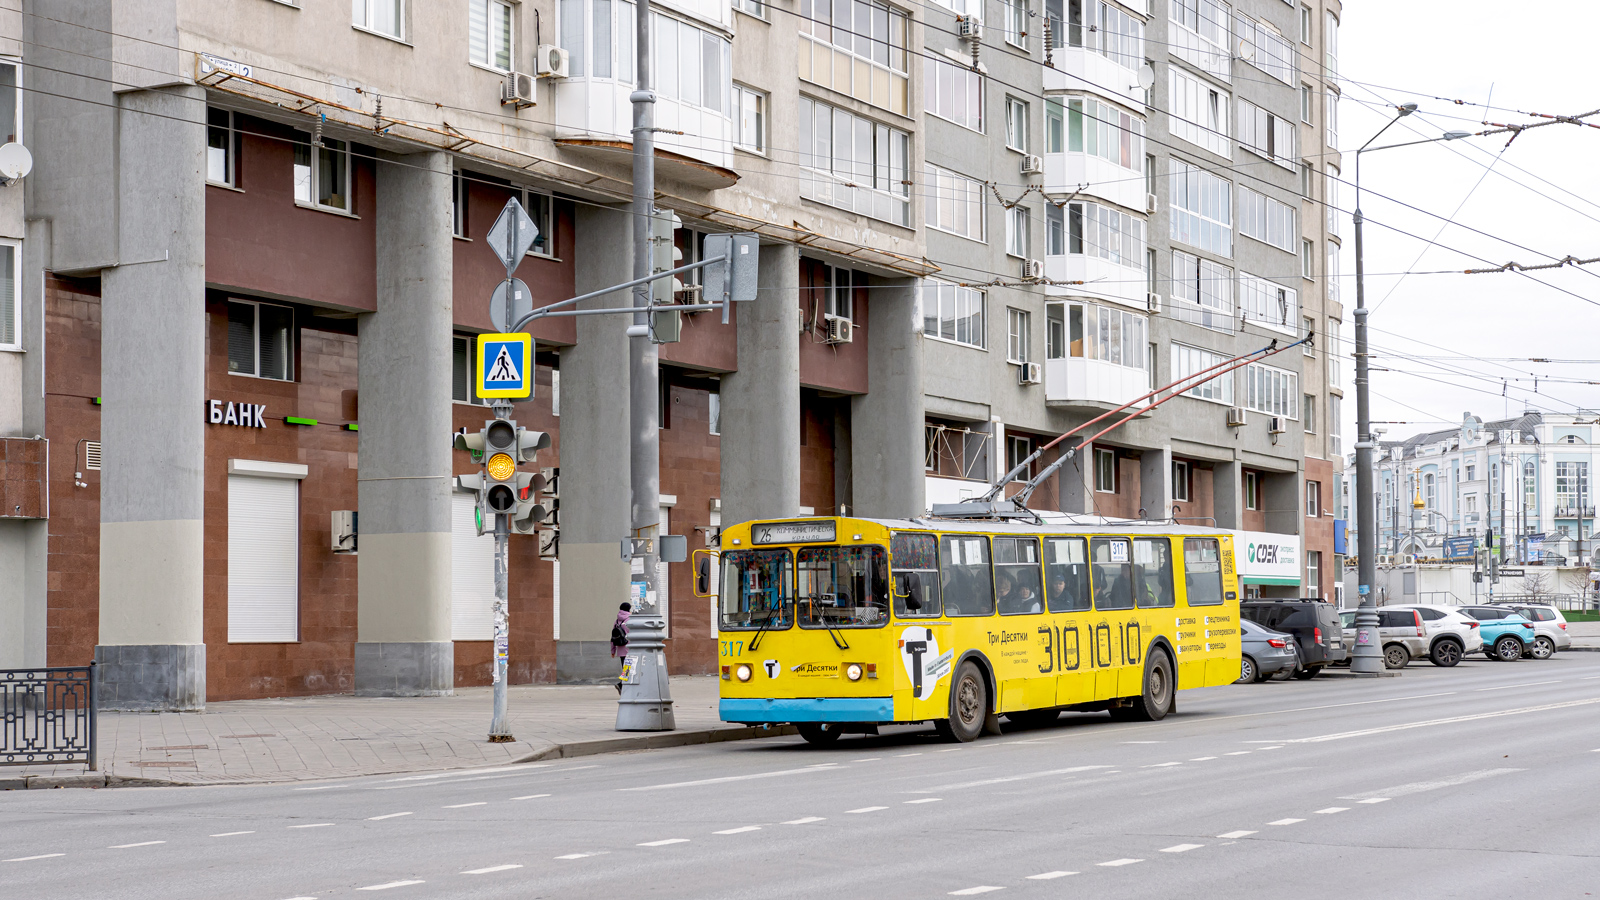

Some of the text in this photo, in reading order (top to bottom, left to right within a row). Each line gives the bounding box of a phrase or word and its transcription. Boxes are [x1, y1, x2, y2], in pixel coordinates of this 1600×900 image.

[210, 399, 267, 428] БАНК
[760, 528, 772, 543] 26
[1113, 542, 1124, 555] 317
[1177, 617, 1196, 626] доставка
[987, 630, 1028, 646] Три Десятки
[721, 641, 743, 656] 317
[807, 664, 838, 673] Десятки
